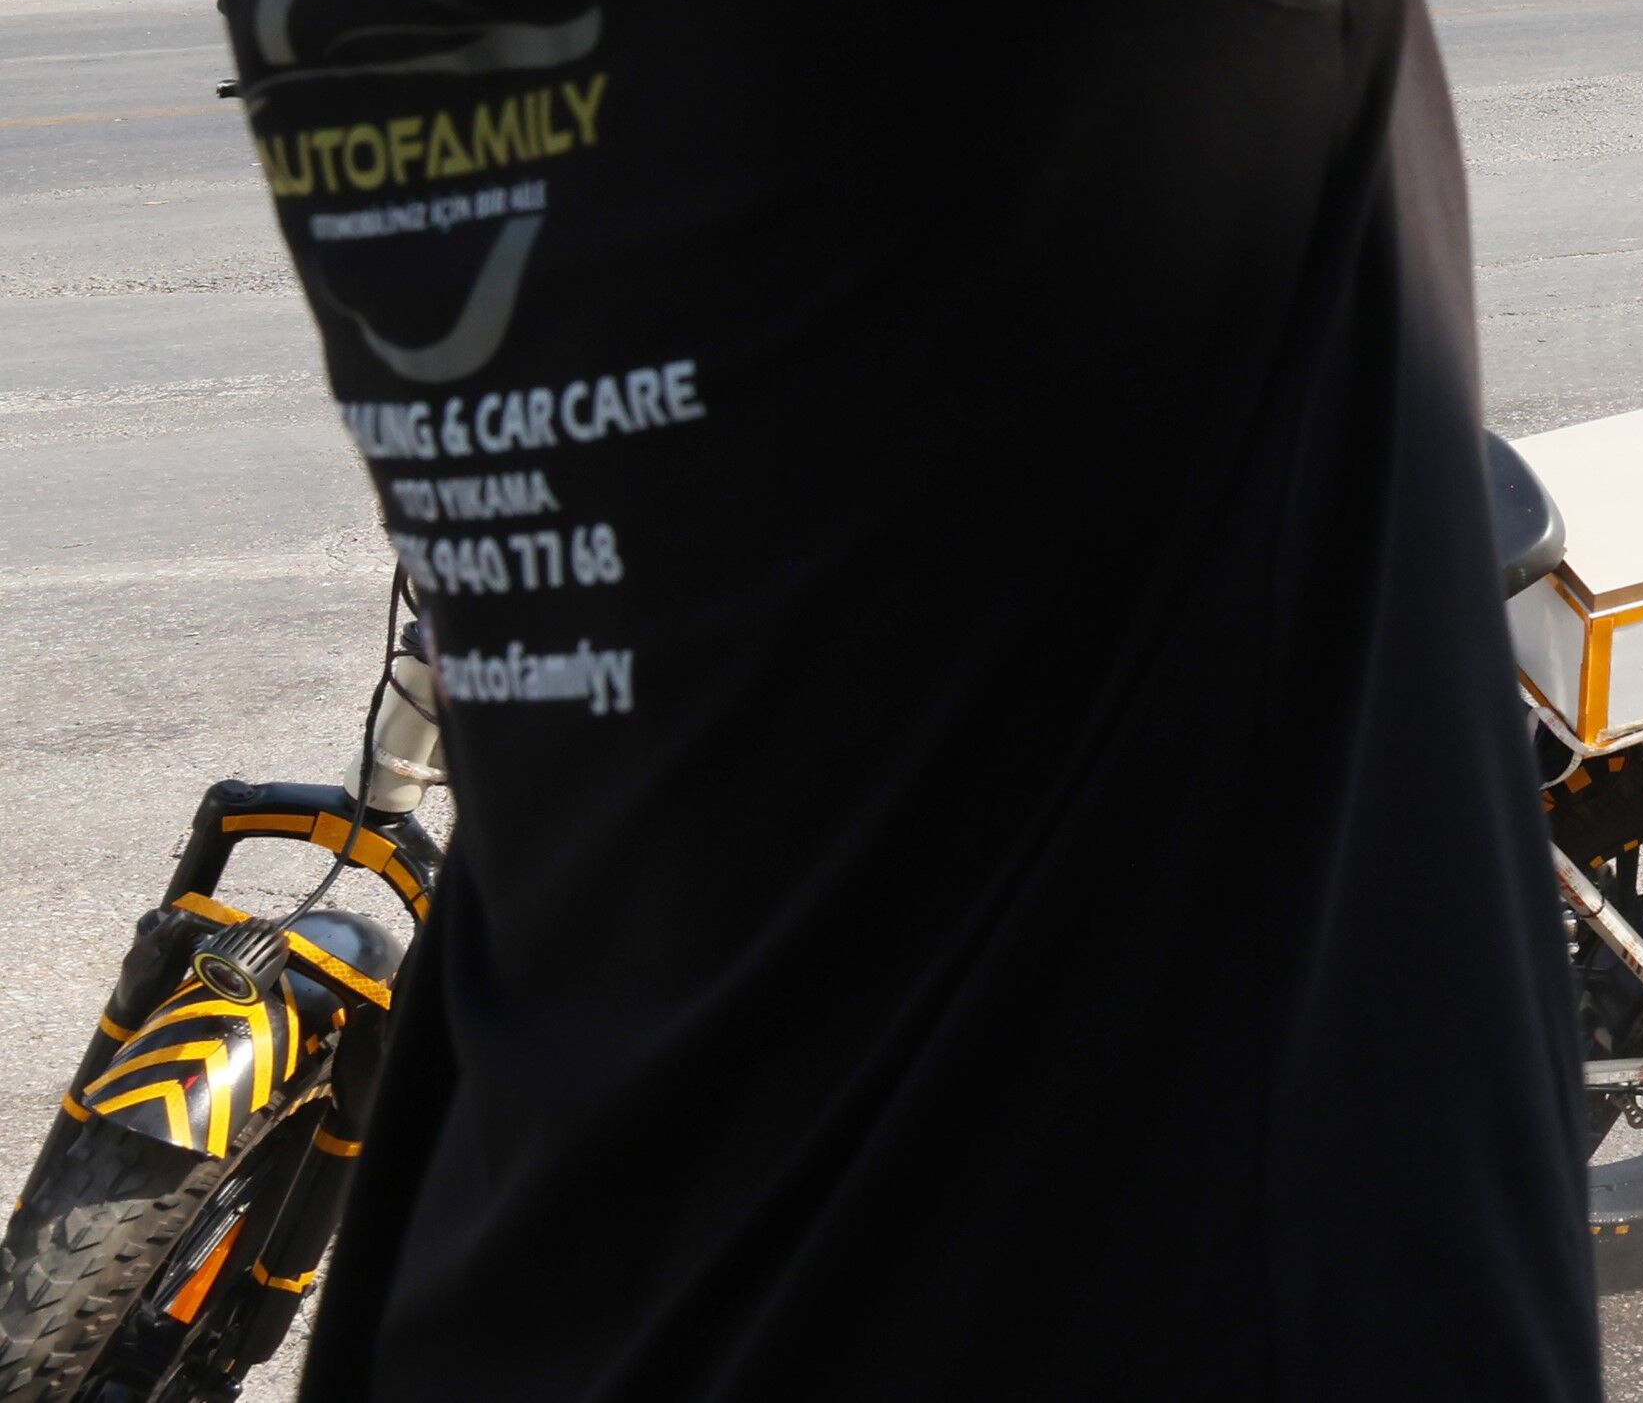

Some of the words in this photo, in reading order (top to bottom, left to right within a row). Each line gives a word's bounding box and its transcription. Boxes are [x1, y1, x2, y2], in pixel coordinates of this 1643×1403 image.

[475, 387, 560, 455] CAR
[560, 358, 707, 443] CARE
[507, 529, 564, 590] 77
[571, 522, 624, 586] 68
